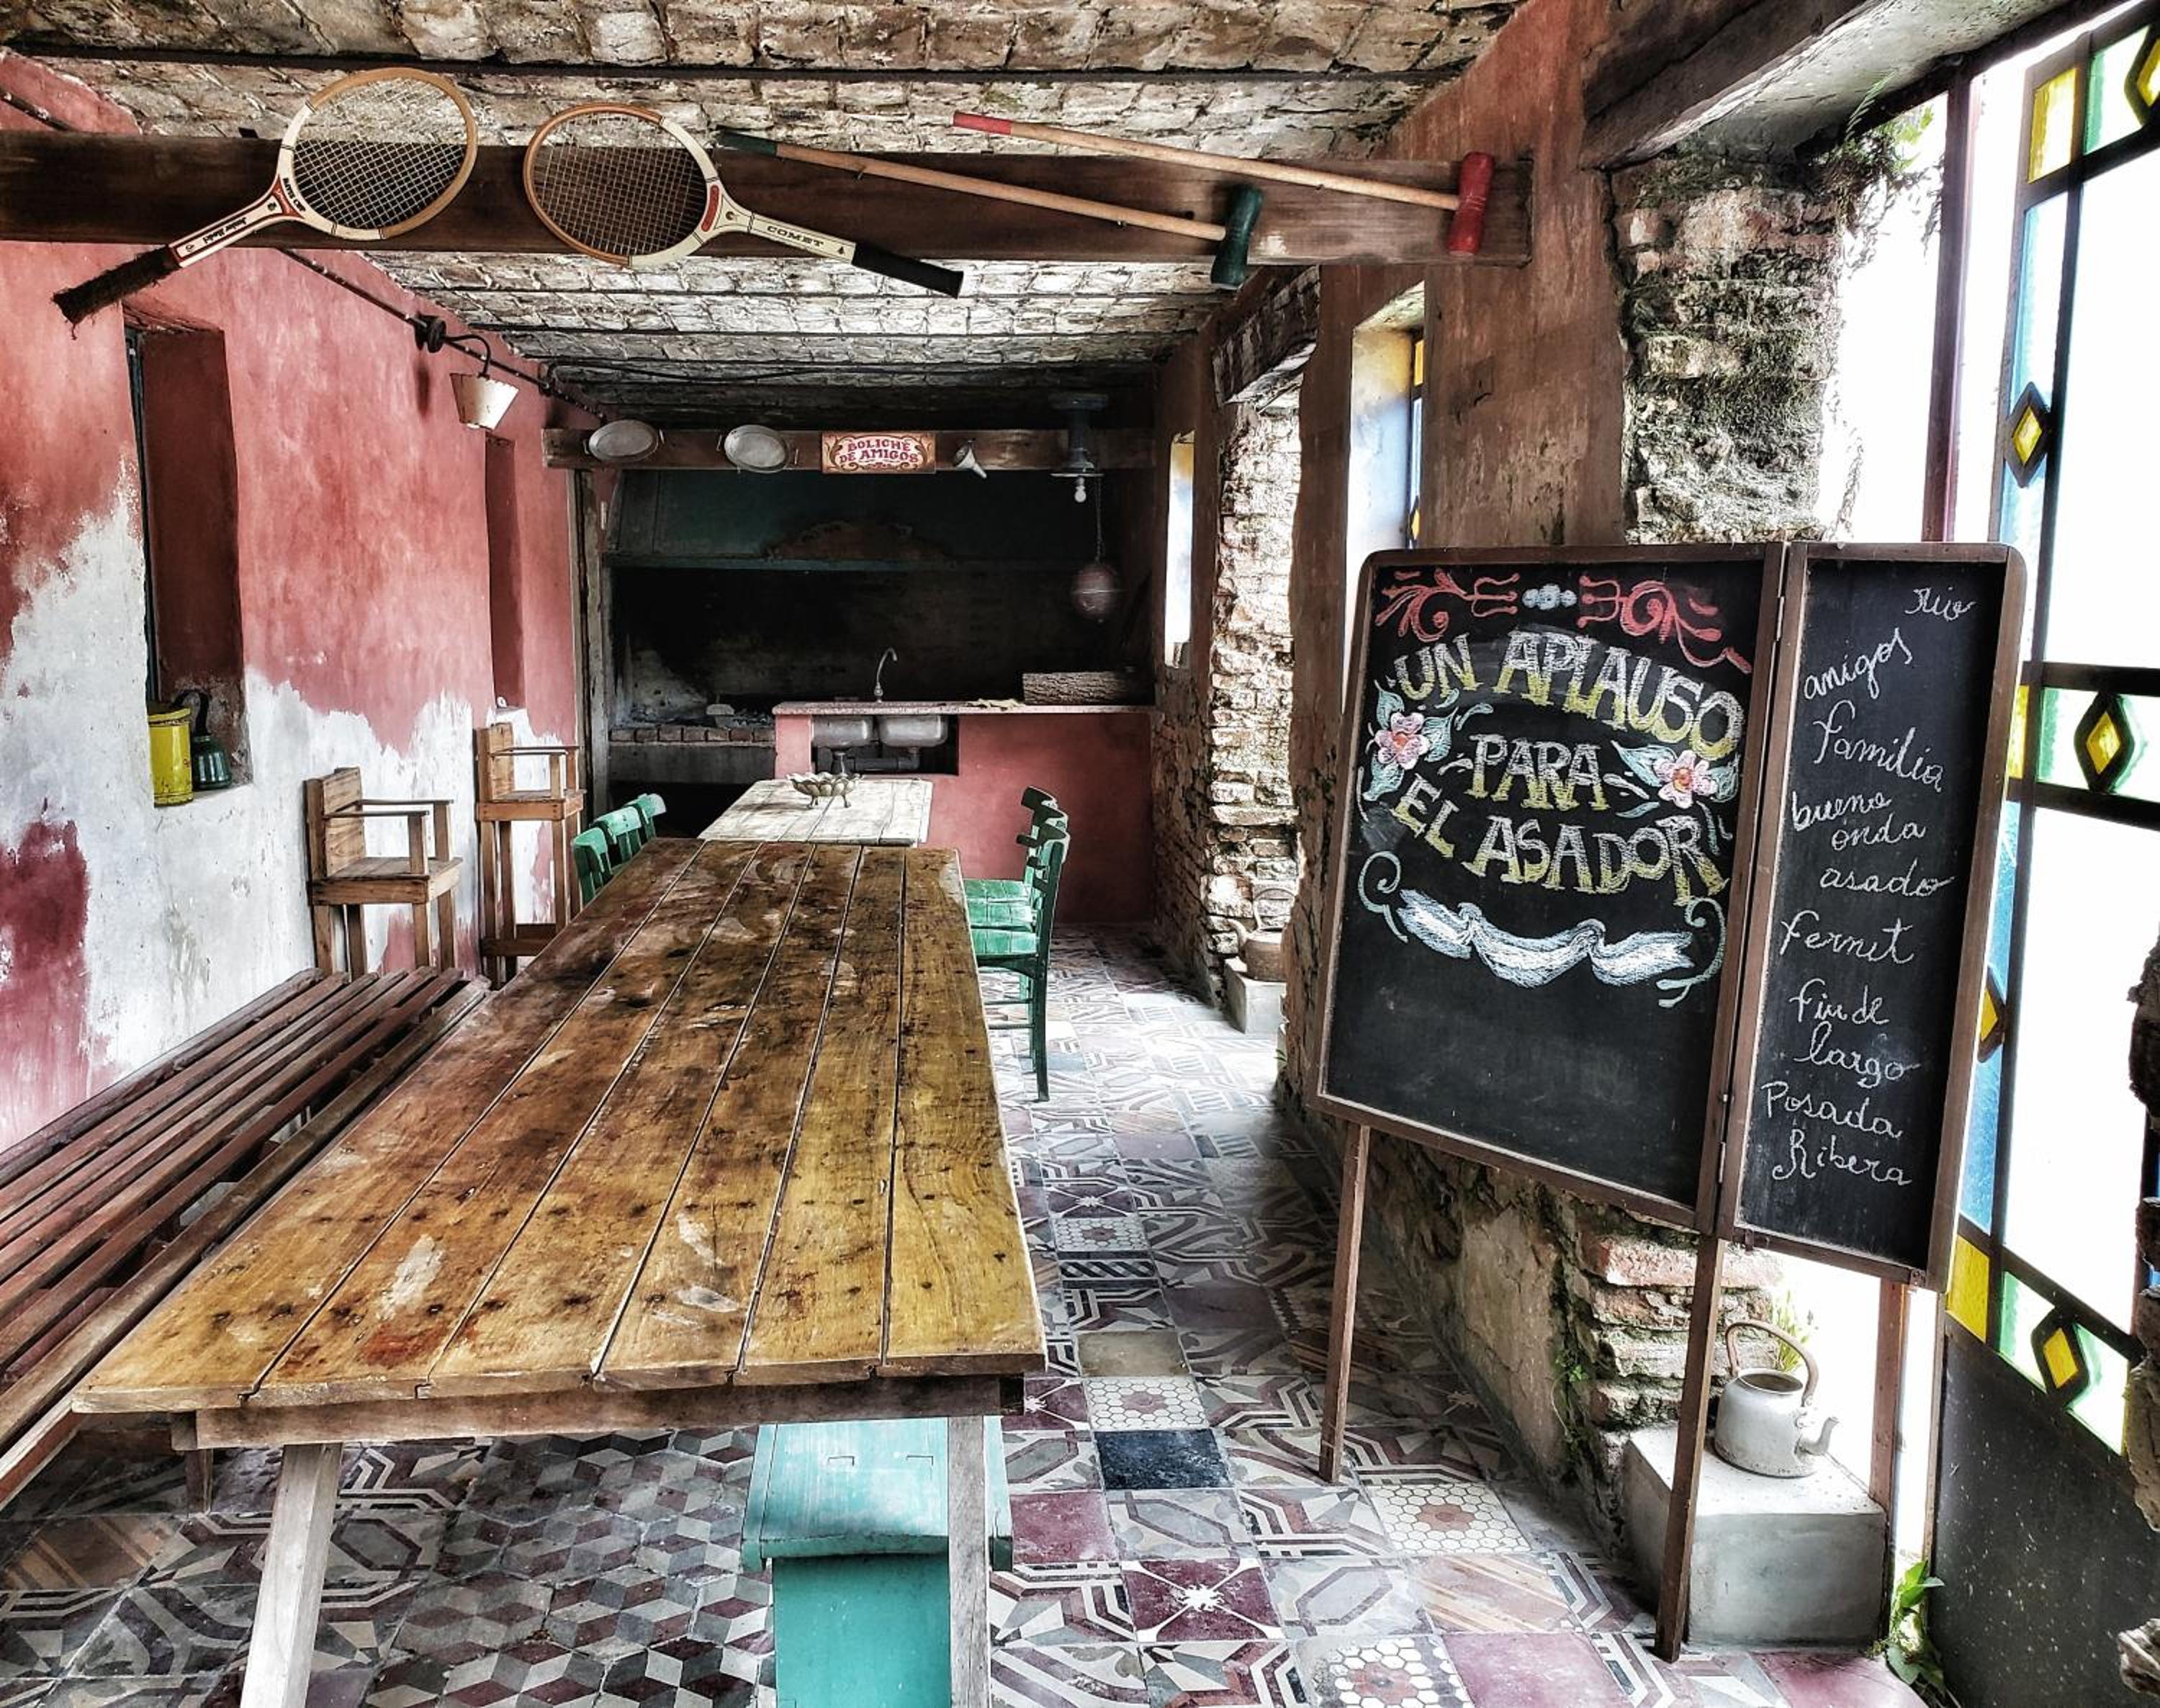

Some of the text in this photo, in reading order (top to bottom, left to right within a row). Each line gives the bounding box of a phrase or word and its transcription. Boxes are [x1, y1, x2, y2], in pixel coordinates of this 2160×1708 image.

[767, 225, 824, 247] COMET
[840, 449, 919, 463] DE AMIGOS
[847, 439, 912, 452] BOLICHE
[1804, 627, 1913, 699] amigos
[1394, 630, 1745, 761] UN APLAUSO
[1463, 733, 1611, 812] PARA
[1388, 773, 1730, 907] EL ASADOR
[1831, 813, 1926, 851] onda
[1793, 1020, 1922, 1087] largo
[1760, 1081, 1904, 1139] Posada
[1772, 1129, 1912, 1186] Ribera
